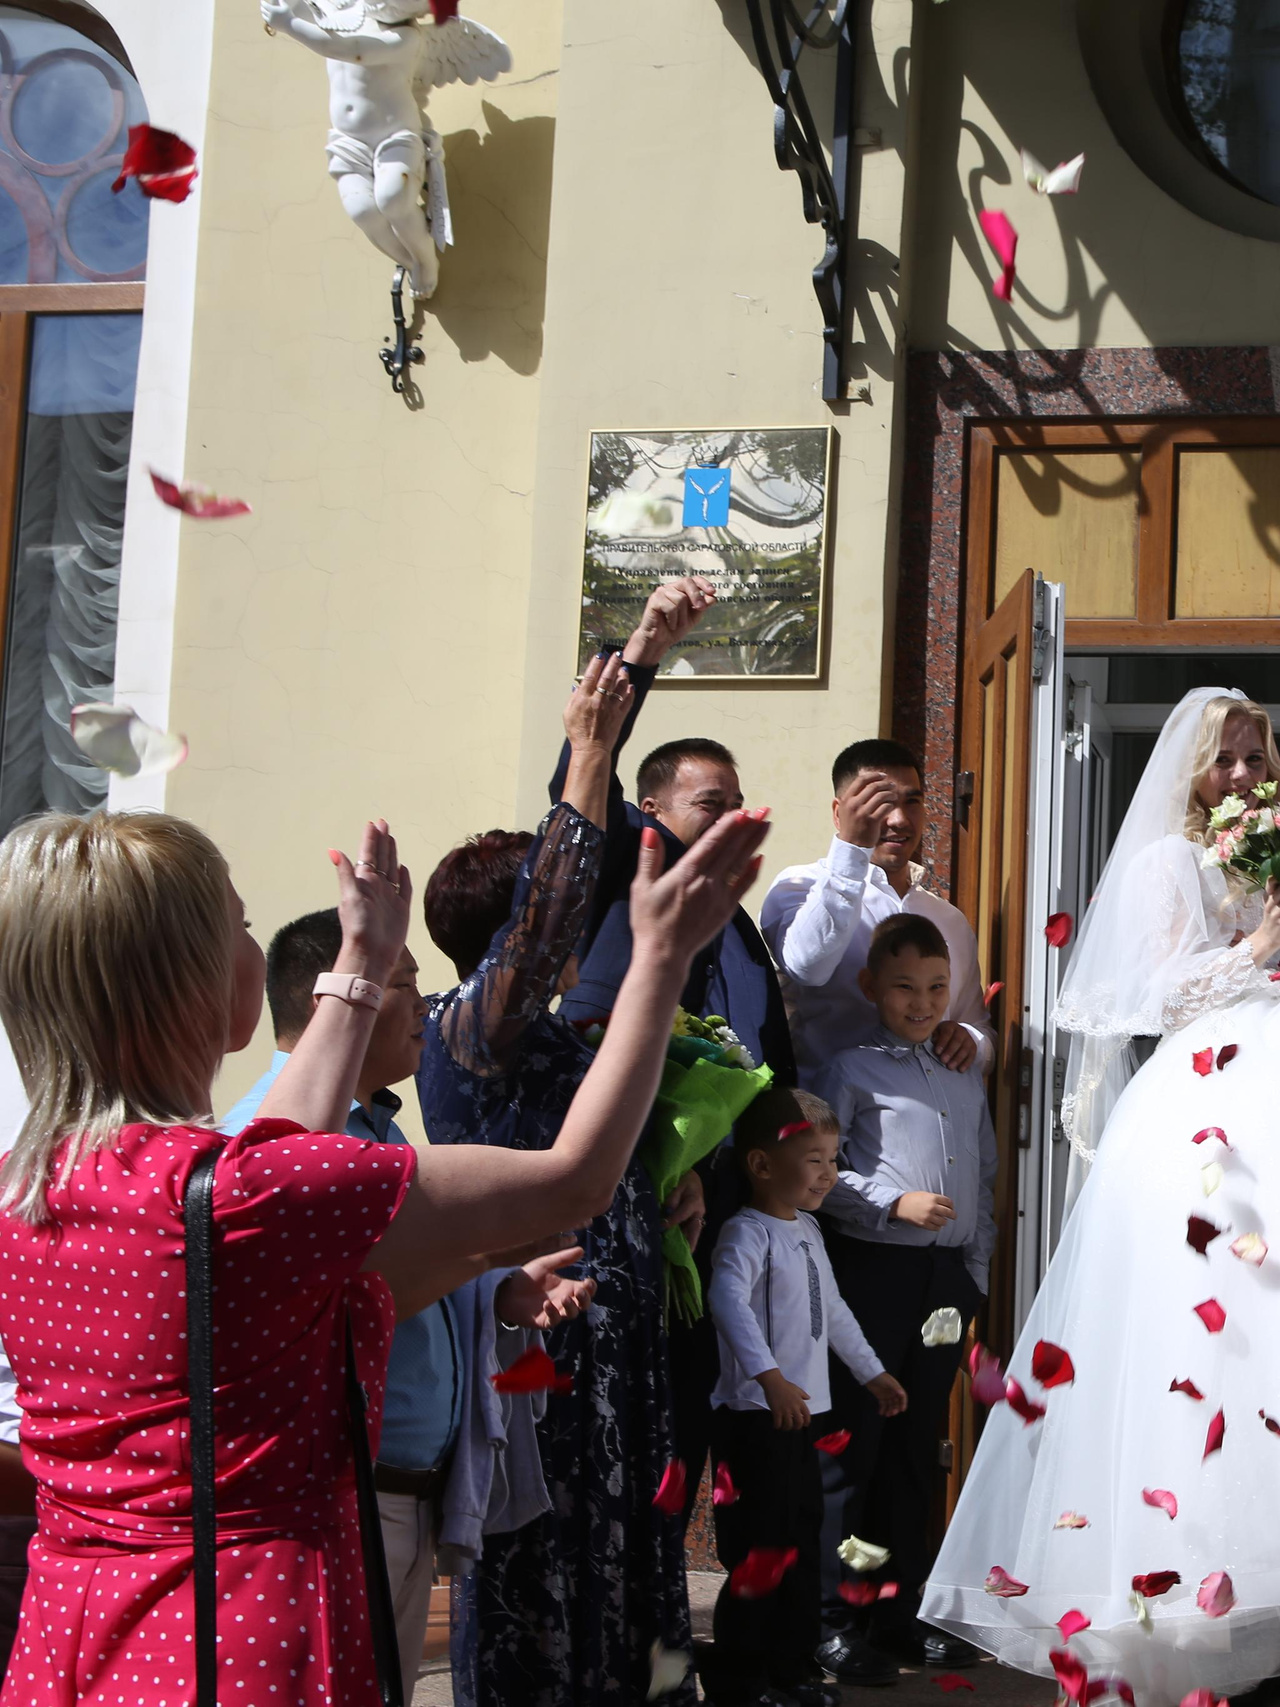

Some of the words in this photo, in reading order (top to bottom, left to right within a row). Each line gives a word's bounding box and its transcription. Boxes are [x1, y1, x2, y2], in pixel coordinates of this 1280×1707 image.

[602, 543, 685, 553] ПРАВИТЕЛЬСТВО
[686, 541, 758, 552] САРАТОВСКОЙ
[761, 542, 807, 551] ОБЛАСТИ
[731, 580, 794, 590] состояния
